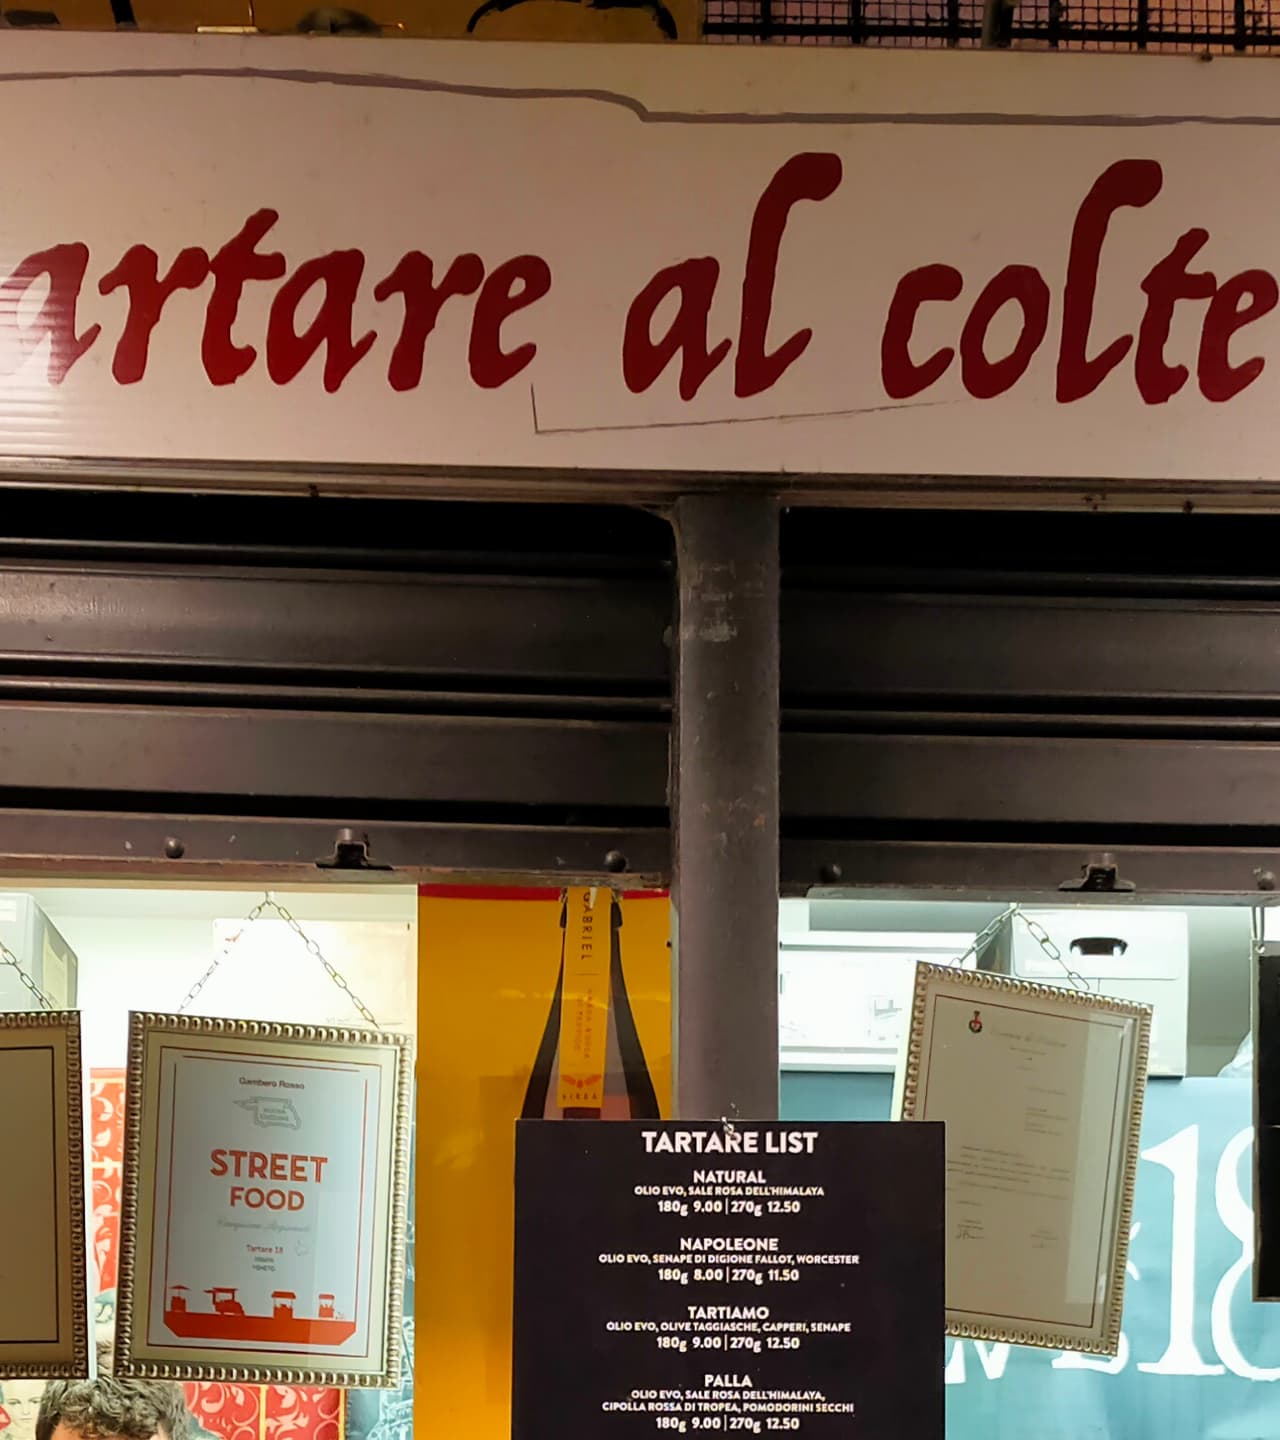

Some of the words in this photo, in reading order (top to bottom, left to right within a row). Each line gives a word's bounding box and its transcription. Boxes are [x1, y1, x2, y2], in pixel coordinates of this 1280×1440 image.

[622, 151, 842, 402] al
[641, 1131, 759, 1154] TARTARE
[765, 1131, 819, 1154] LIST
[210, 1149, 328, 1184] STREET
[693, 1169, 767, 1184] NATURAL
[230, 1185, 305, 1212] FOOD
[634, 1185, 661, 1195] OLIO
[661, 1185, 688, 1196] EVO,
[687, 1185, 714, 1195] SALE
[714, 1185, 744, 1196] ROSA
[744, 1186, 825, 1196] DELL'HIMALAYA
[657, 1200, 689, 1216] 180g
[693, 1200, 723, 1212] 9.00
[730, 1201, 763, 1217] 270g
[766, 1200, 801, 1213] 12.50
[679, 1237, 779, 1252] NAPOLEONE
[657, 1268, 689, 1285] 180g
[693, 1268, 724, 1280] 8.00
[731, 1269, 764, 1286] 270g
[767, 1269, 800, 1281] 11.50
[687, 1305, 770, 1320] TARTIAMO
[704, 1373, 753, 1388] PALLA
